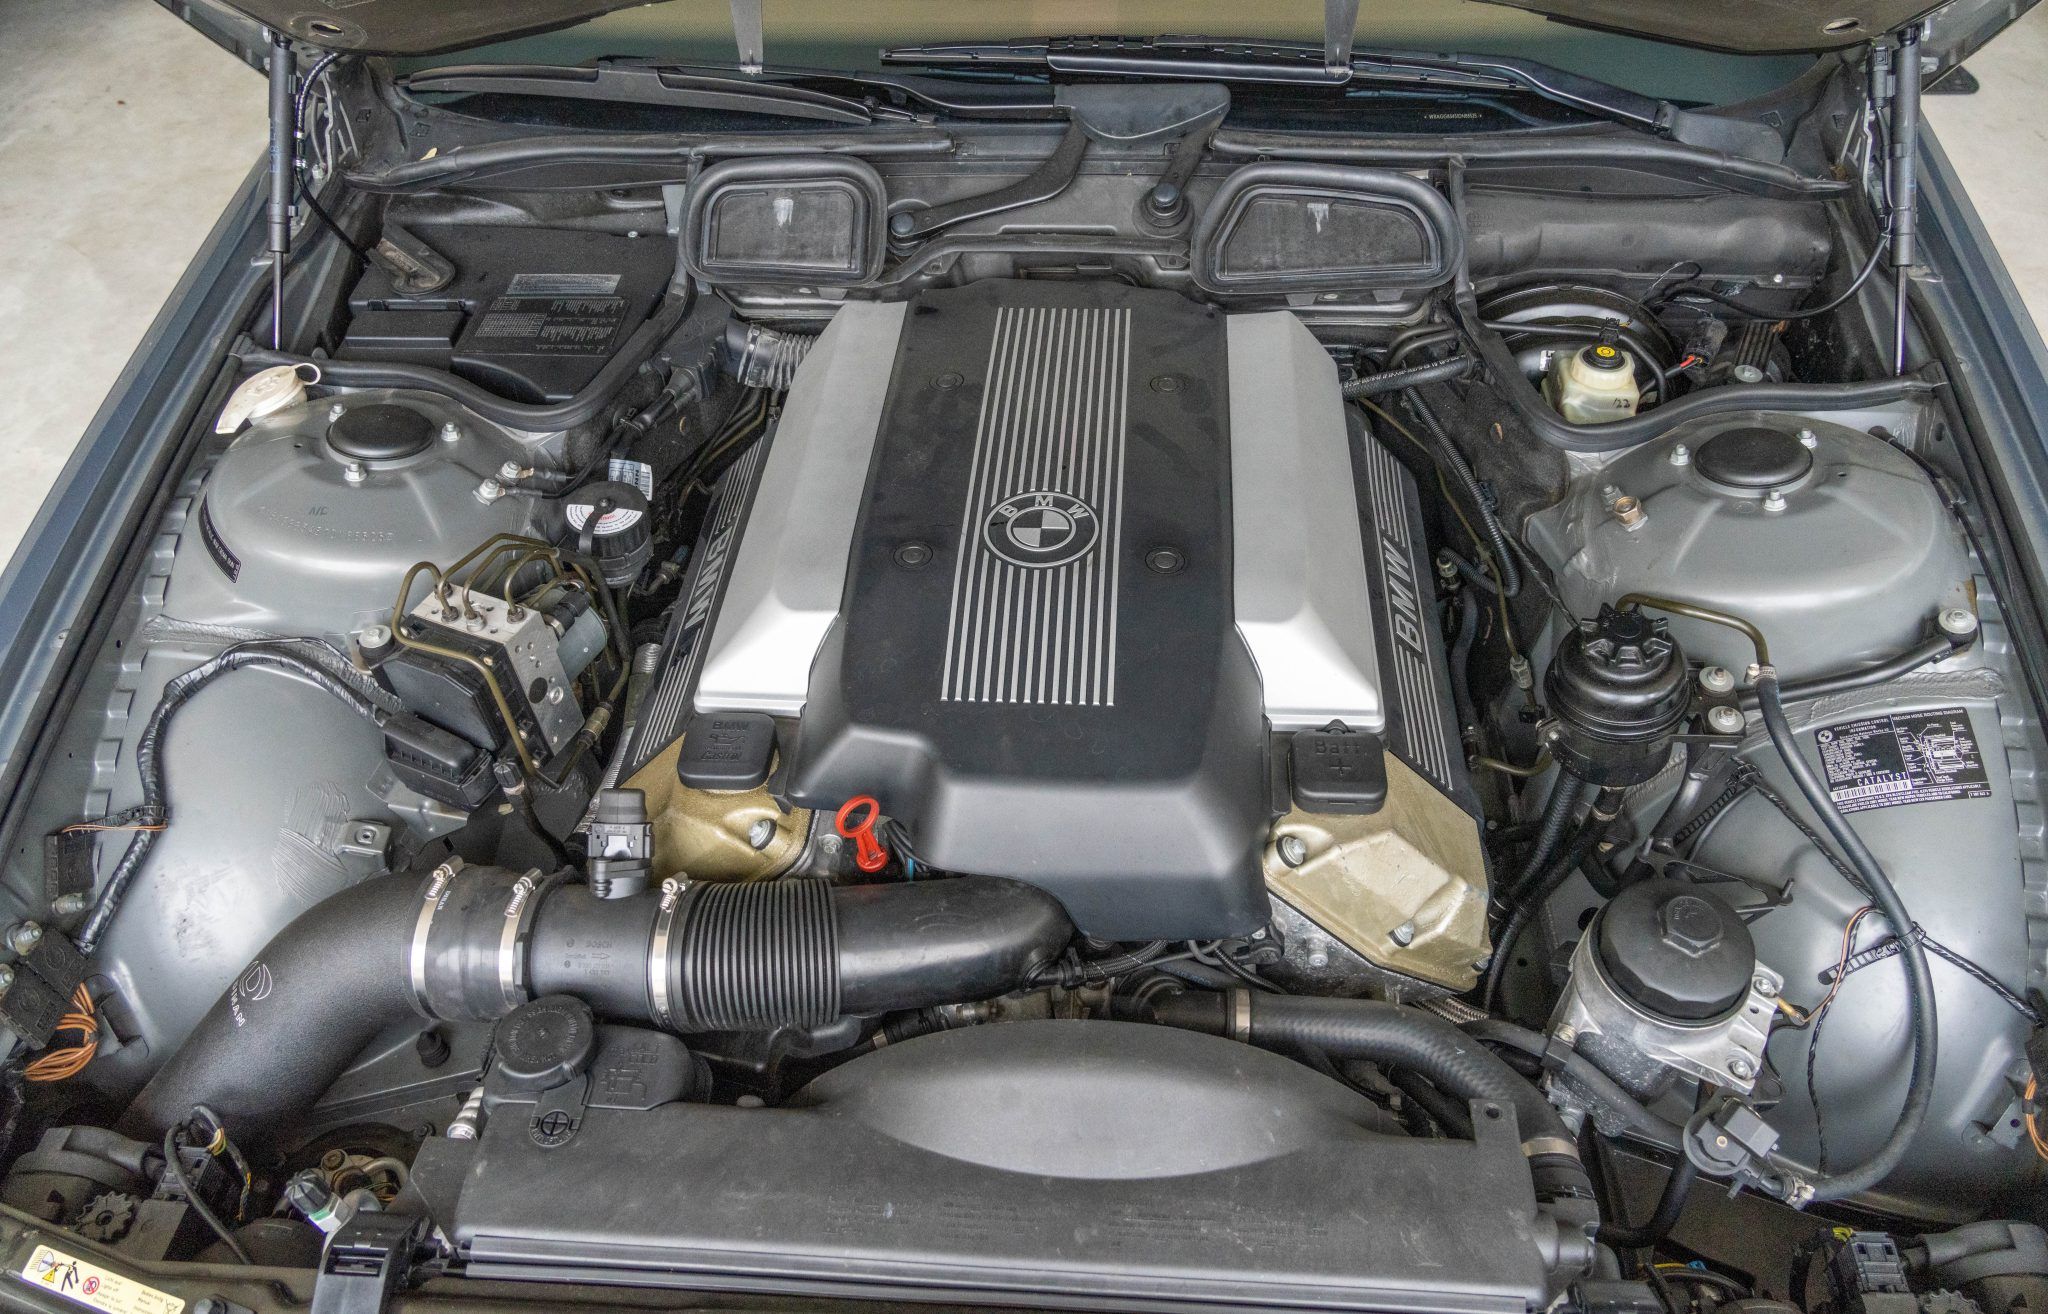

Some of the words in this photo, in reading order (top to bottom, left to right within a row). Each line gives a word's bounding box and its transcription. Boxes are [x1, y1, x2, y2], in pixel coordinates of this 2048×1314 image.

[999, 495, 1090, 519] BMW
[684, 525, 733, 631] BMW
[1382, 536, 1423, 653] BMW
[1856, 771, 1908, 787] CATALYST
[437, 890, 451, 911] DINAN
[231, 979, 246, 1028] DINAN
